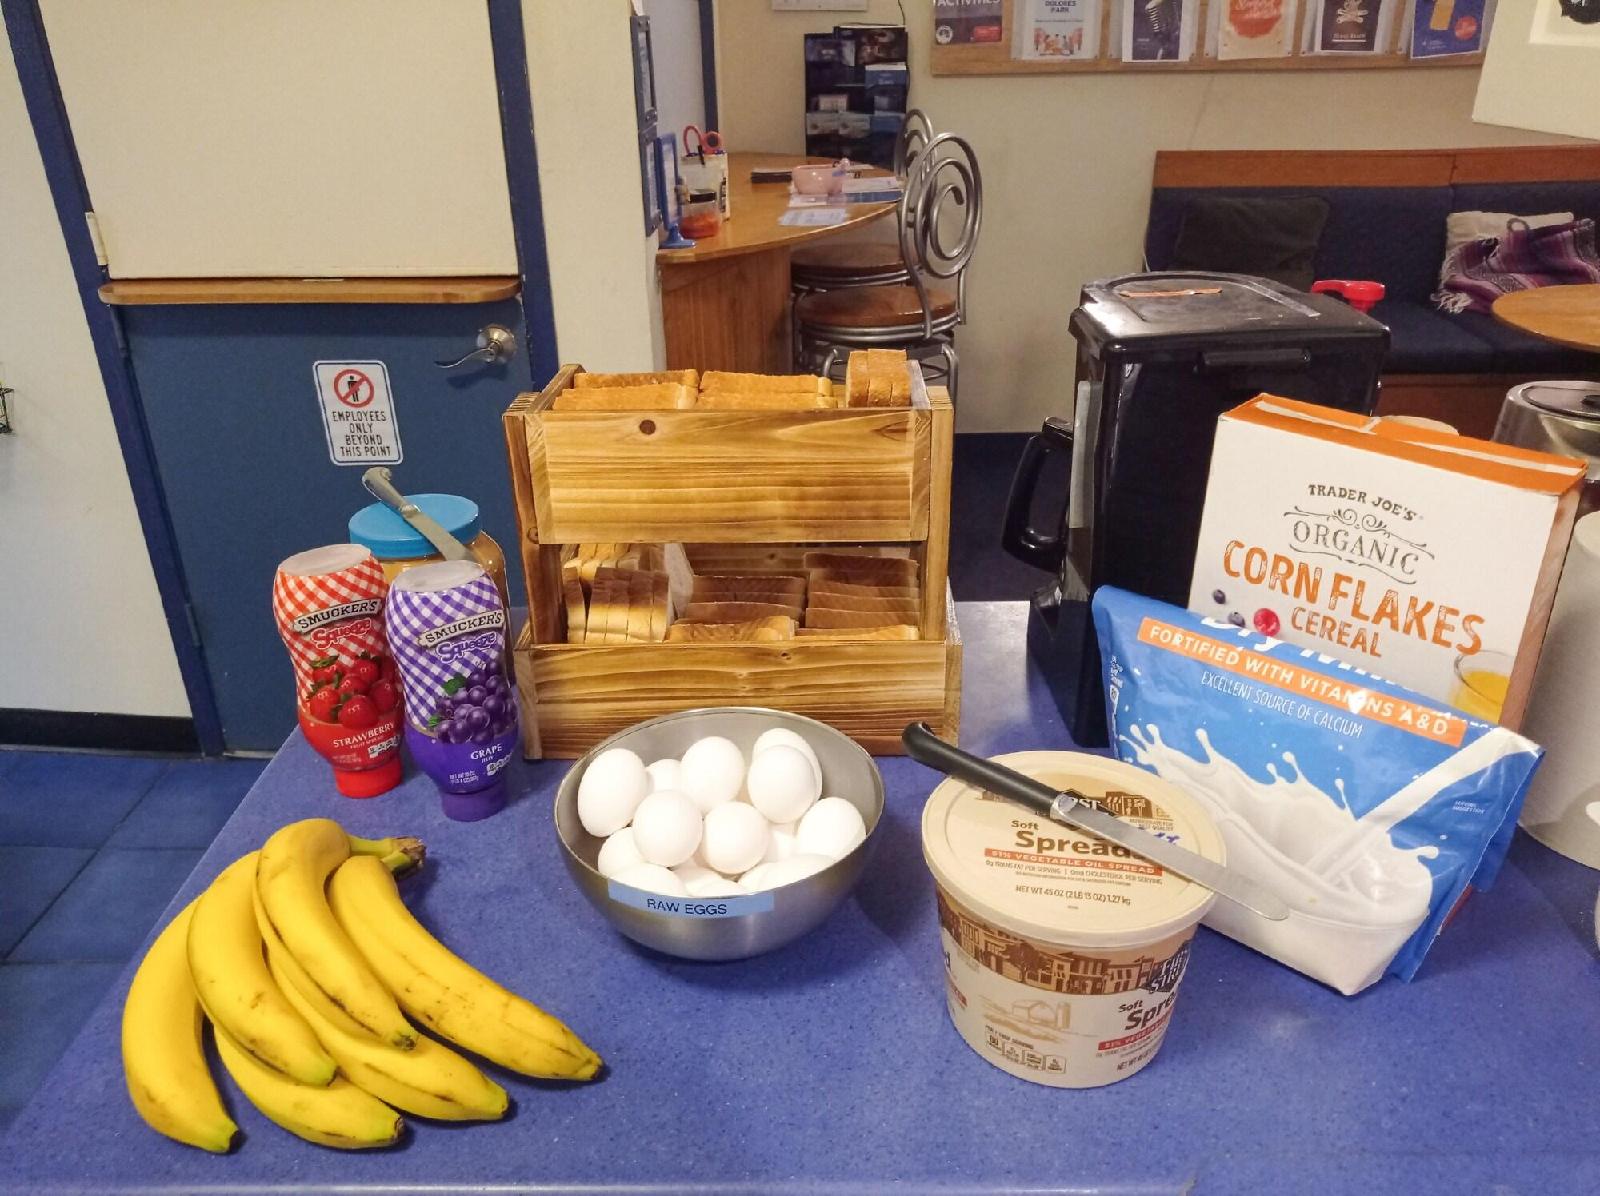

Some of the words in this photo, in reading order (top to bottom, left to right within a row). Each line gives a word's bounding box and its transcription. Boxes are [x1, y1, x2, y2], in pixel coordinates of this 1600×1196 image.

[332, 411, 387, 421] EMPLOYEES
[349, 423, 373, 433] ONLY
[340, 446, 362, 457] THIS
[365, 446, 391, 457] POINT
[345, 435, 382, 446] BEYOND
[1308, 484, 1367, 504] TRADER
[1372, 496, 1416, 521] JOE'S
[1293, 520, 1420, 575] ORGANIC
[1224, 540, 1322, 604] CORN
[1328, 573, 1485, 656] FLAKES
[297, 600, 379, 629] SMUCKER'S
[425, 611, 504, 643] SMUCKER'S
[1291, 607, 1382, 658] CEREAL
[1150, 626, 1239, 665] FORTIFIED
[1245, 656, 1294, 684] WITH
[1300, 675, 1394, 717] VITAMNS
[1398, 708, 1413, 725] A
[1416, 713, 1431, 729] &
[1432, 719, 1448, 736] D
[1201, 671, 1254, 701] EXCELLENT
[1254, 689, 1296, 716] SOURCE
[1297, 703, 1315, 720] OF
[1314, 710, 1364, 738] CALCIUM
[333, 722, 394, 748] STRAWBERRY
[470, 743, 503, 760] GRAPE
[1011, 819, 1039, 831] Soft
[1016, 854, 1080, 866] VEGETABLE
[1085, 860, 1105, 868] OIL
[1108, 863, 1155, 874] SPREAD
[1015, 885, 1029, 893] NET
[1030, 887, 1043, 895] WT
[1054, 889, 1064, 897] OZ
[646, 898, 681, 913] RAW
[685, 903, 728, 915] EGGS
[1118, 1000, 1143, 1013] Soft
[1125, 992, 1175, 1031] Spre
